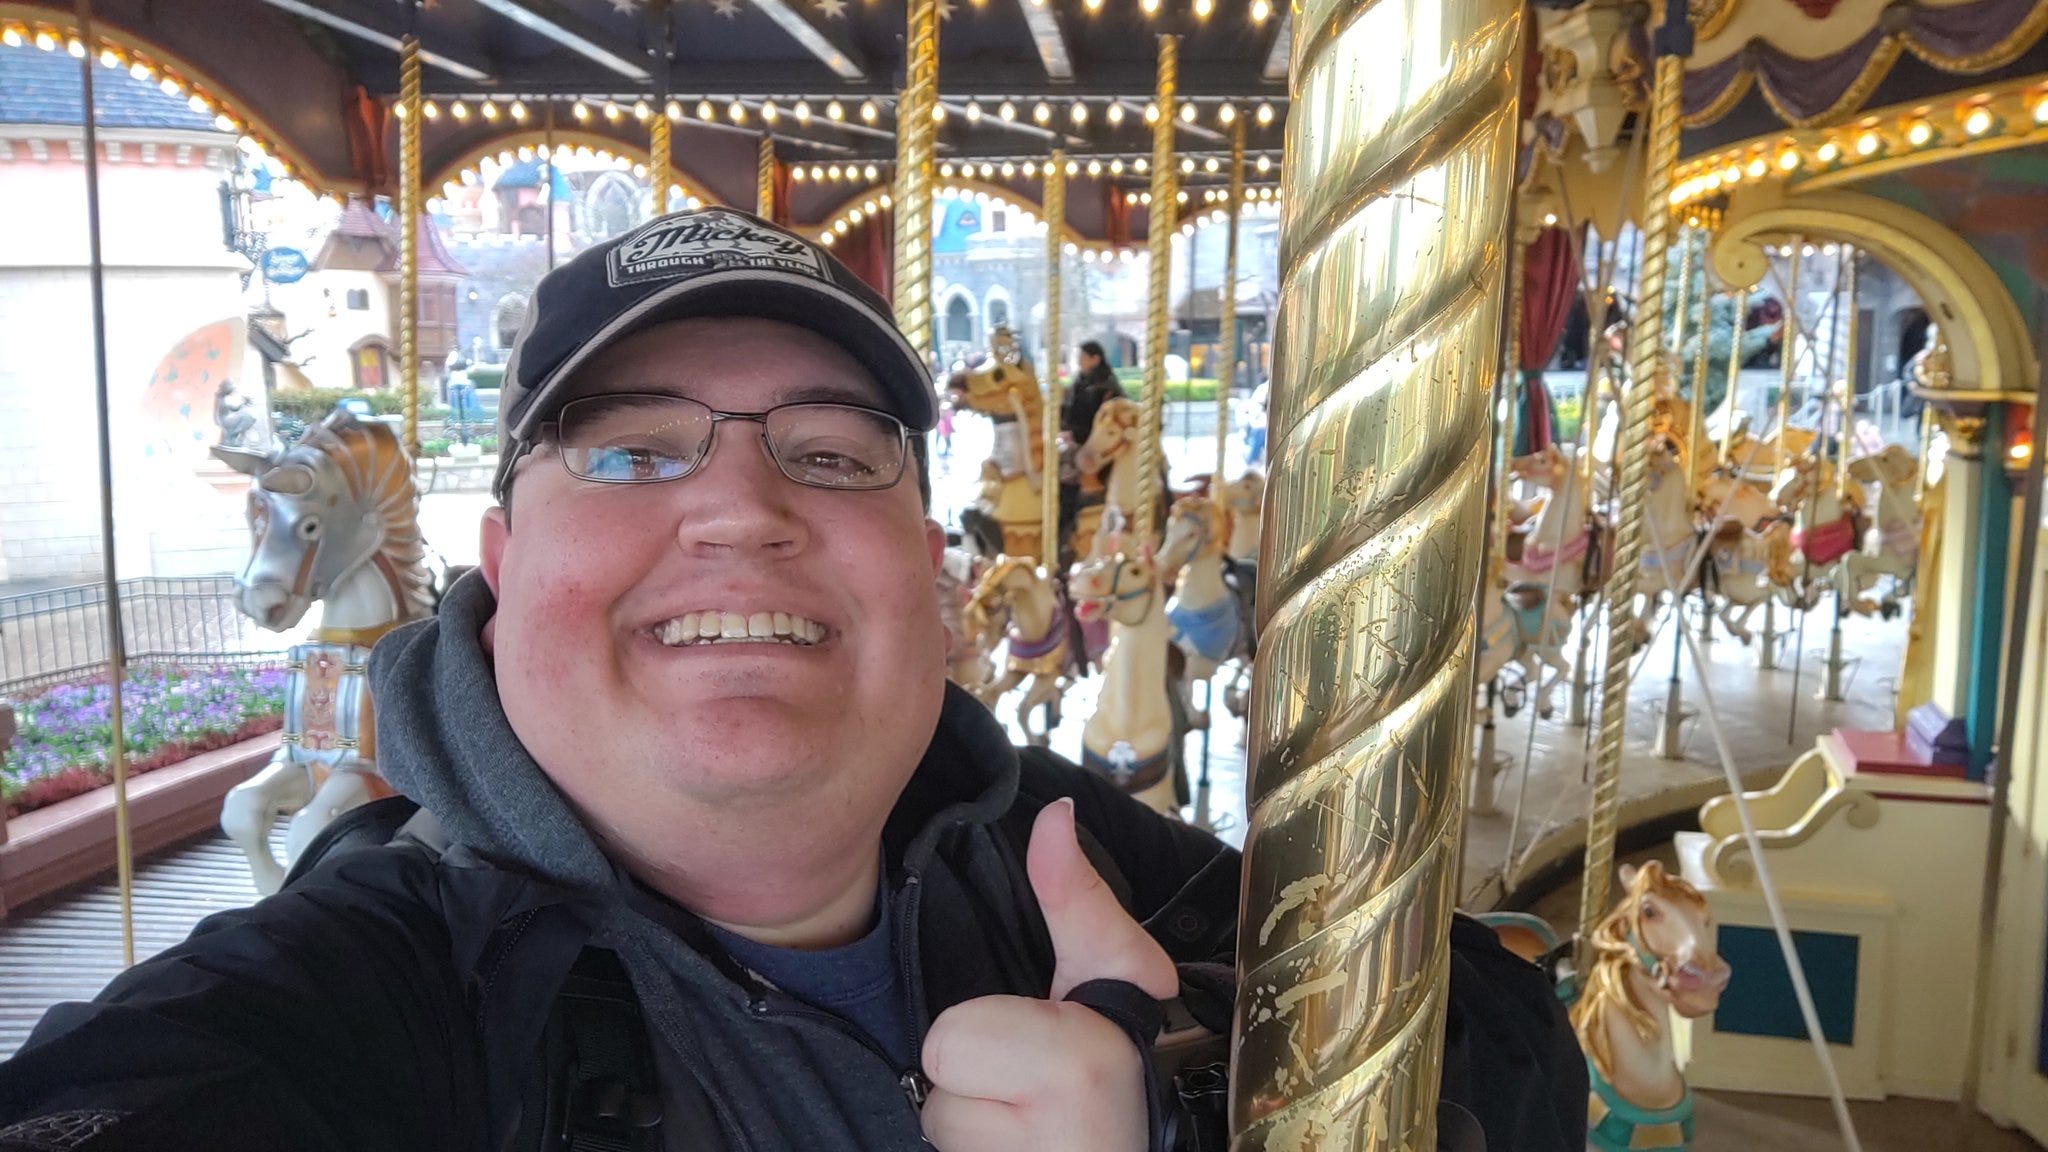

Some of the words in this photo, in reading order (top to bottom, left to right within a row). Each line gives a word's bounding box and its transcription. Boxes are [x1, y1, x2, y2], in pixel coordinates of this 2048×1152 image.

[626, 224, 808, 263] Mickey
[626, 257, 705, 274] THROUGH
[749, 258, 774, 266] THE
[776, 260, 818, 276] YEARS
